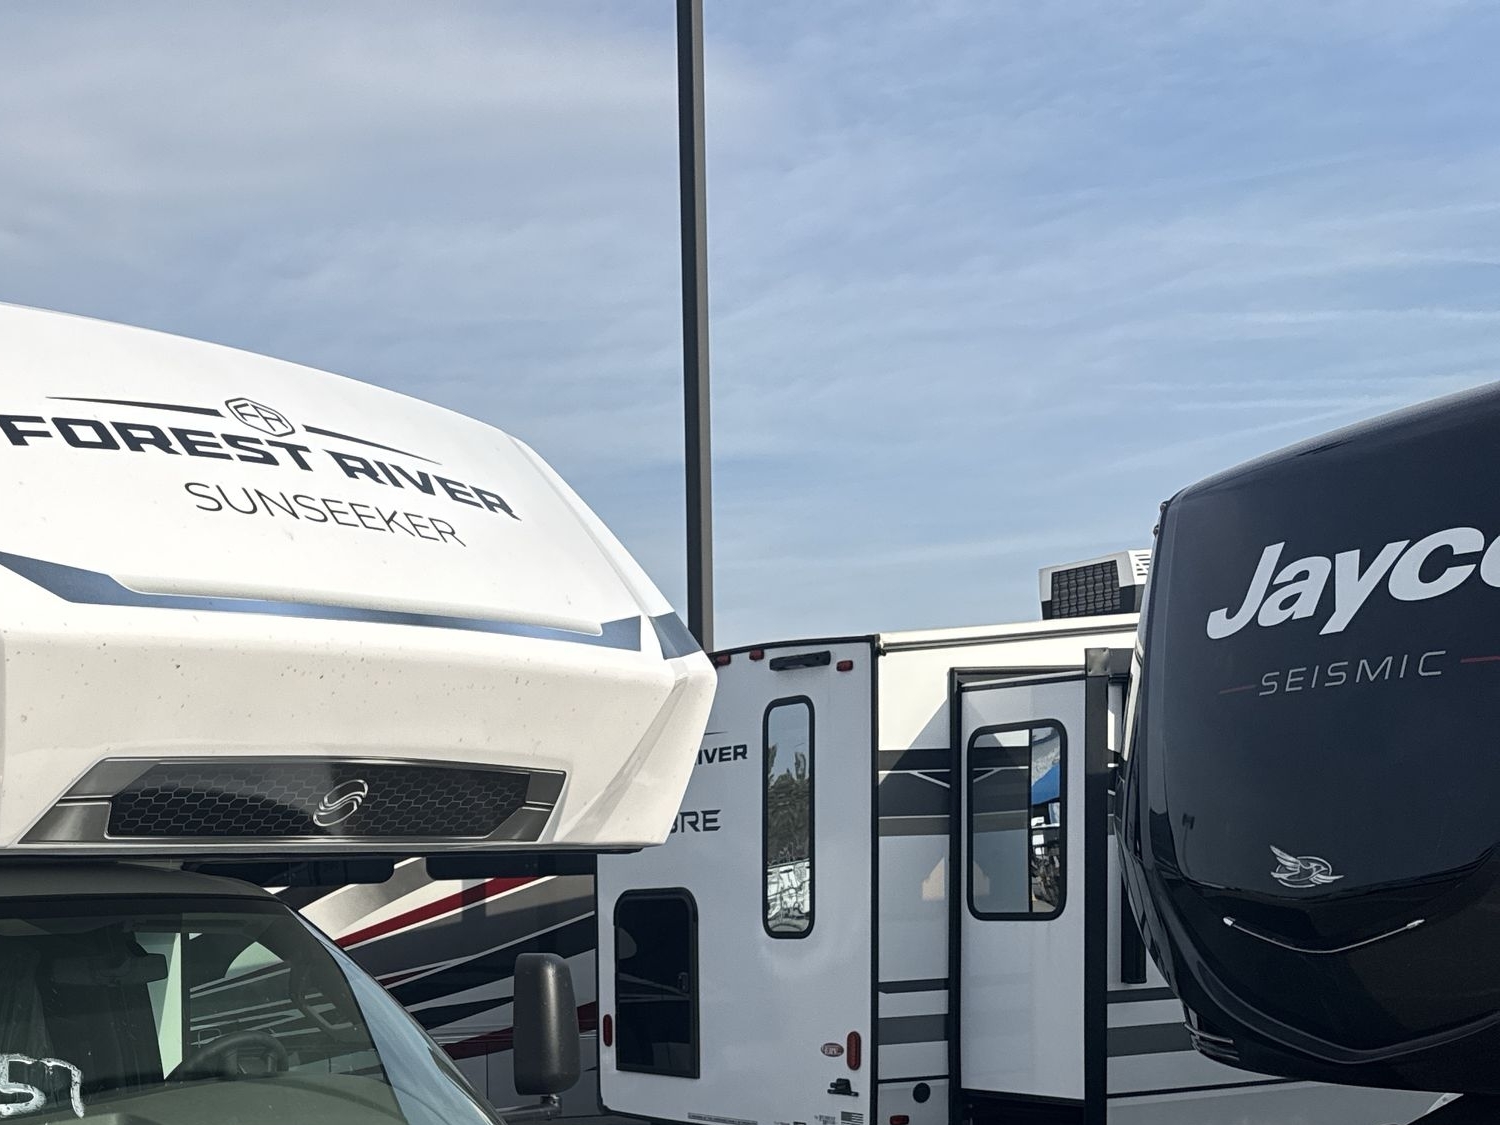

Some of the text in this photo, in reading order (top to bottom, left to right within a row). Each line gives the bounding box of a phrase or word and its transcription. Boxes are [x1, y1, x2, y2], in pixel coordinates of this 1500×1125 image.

[184, 482, 466, 547] SUNSEEKER
[322, 448, 522, 521] RIVER
[1206, 526, 1500, 640] Jayc
[1259, 650, 1446, 696] SEISMIC
[694, 744, 748, 766] IVER
